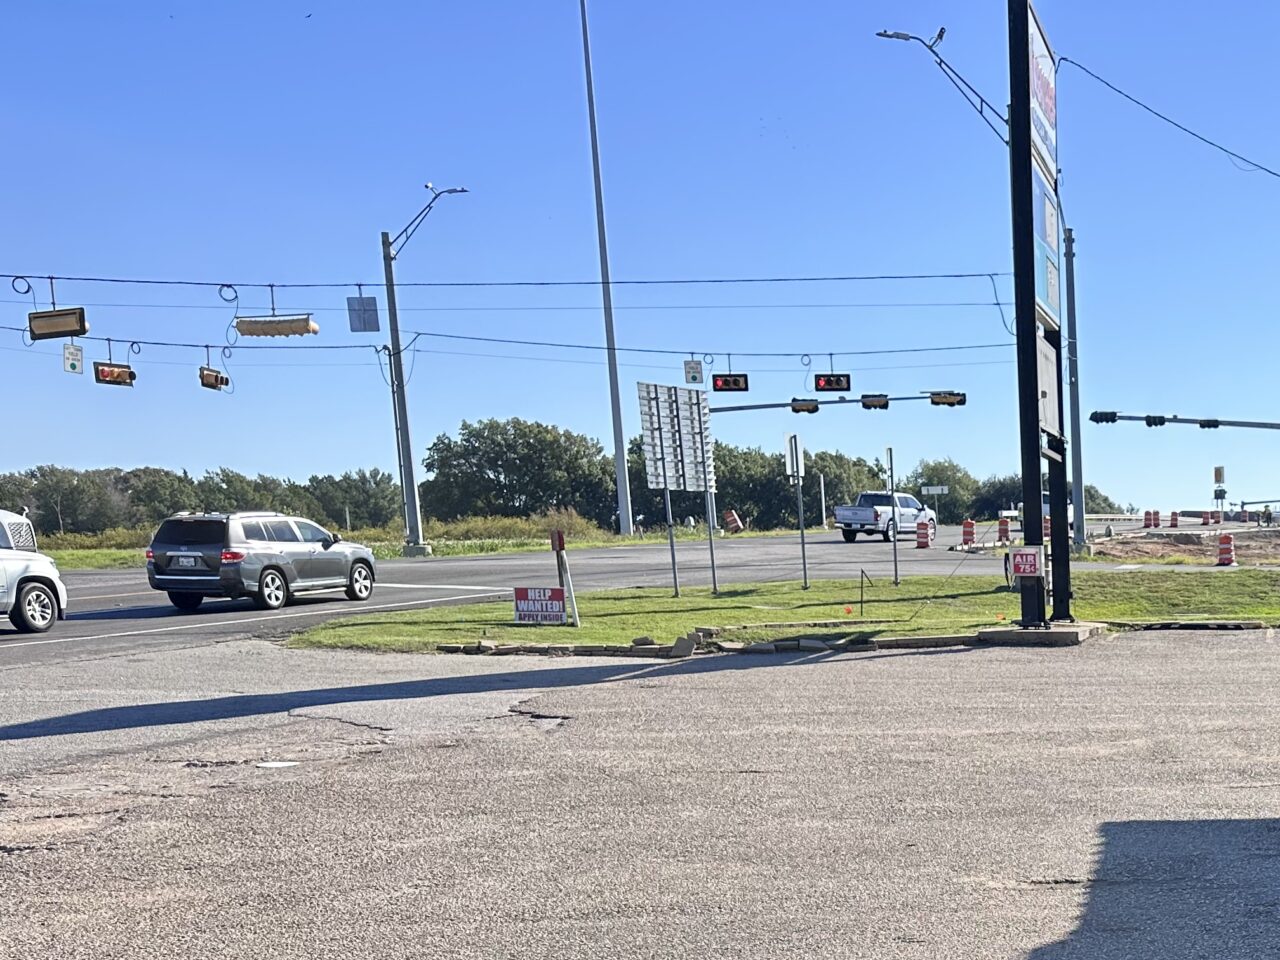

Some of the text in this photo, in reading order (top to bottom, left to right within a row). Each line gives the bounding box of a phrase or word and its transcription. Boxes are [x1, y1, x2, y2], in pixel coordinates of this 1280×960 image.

[1015, 555, 1035, 565] AIR
[527, 589, 552, 600] HELP
[517, 600, 563, 612] WANTED!
[519, 613, 563, 622] APPLY INSIDE
